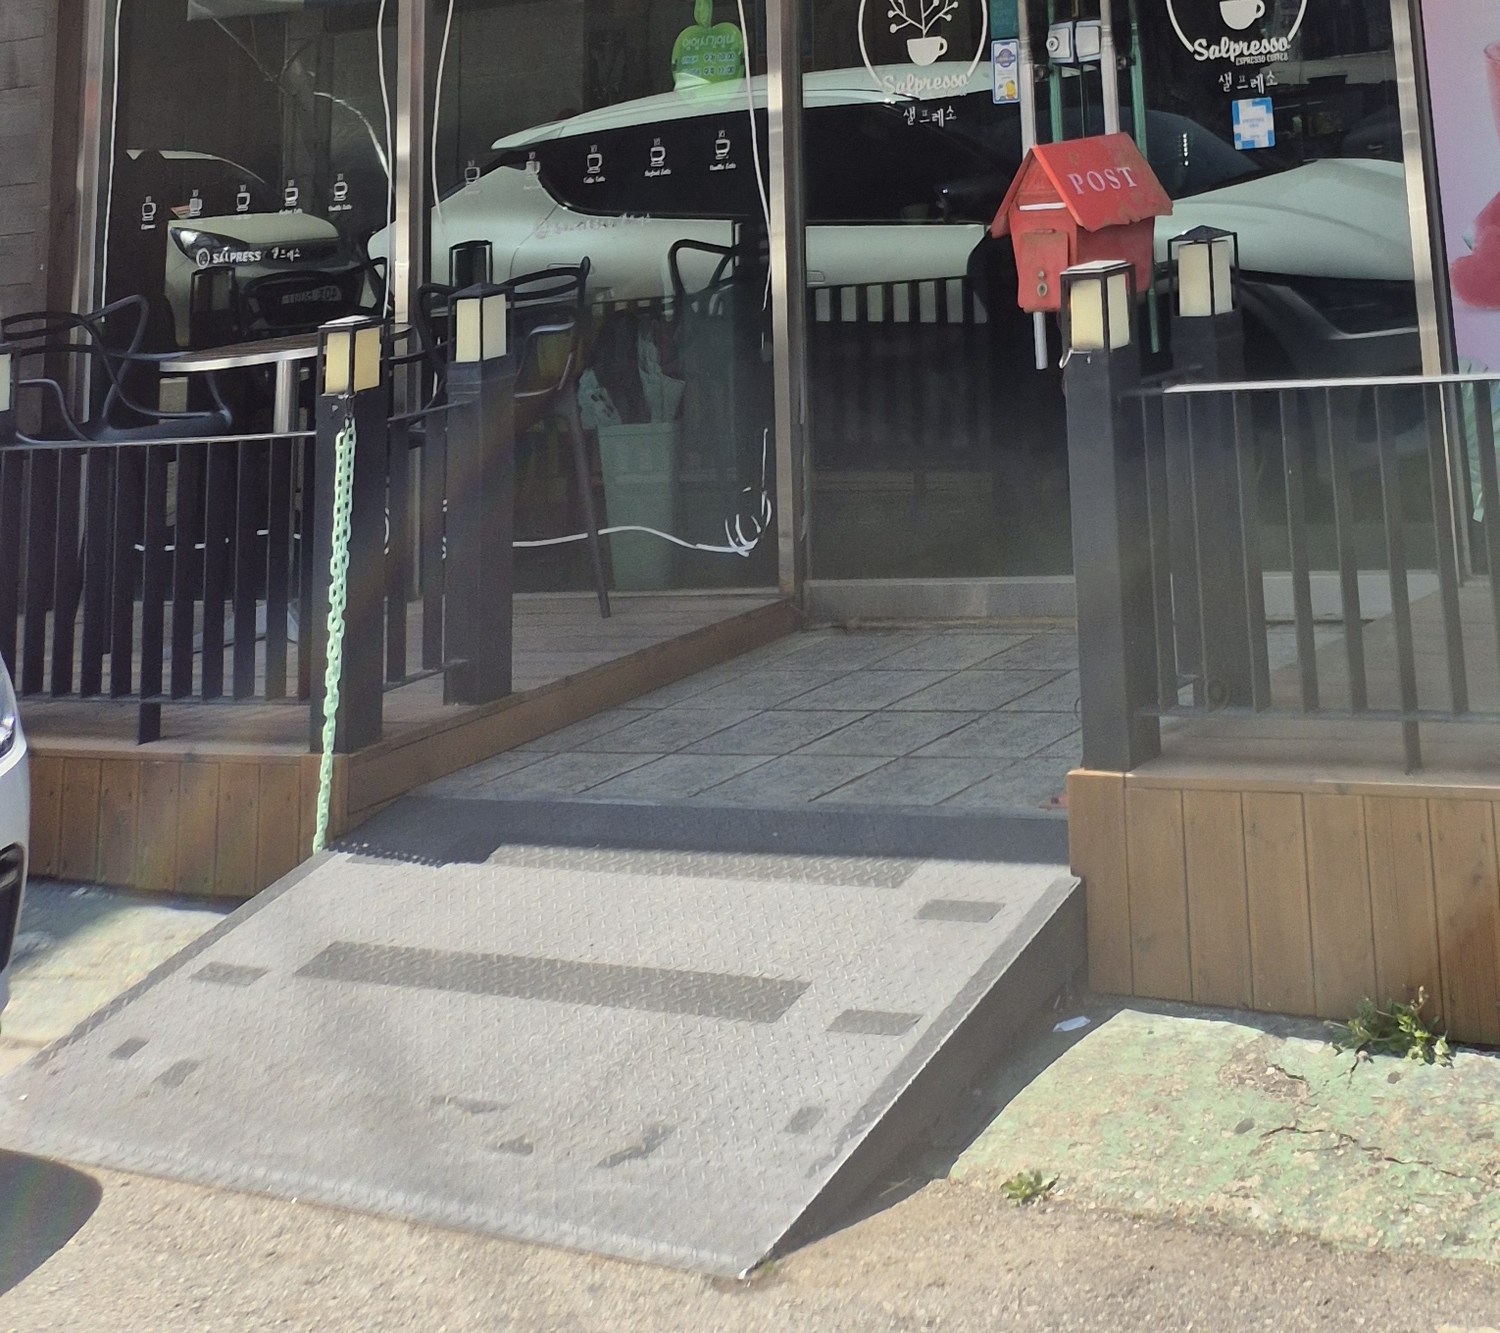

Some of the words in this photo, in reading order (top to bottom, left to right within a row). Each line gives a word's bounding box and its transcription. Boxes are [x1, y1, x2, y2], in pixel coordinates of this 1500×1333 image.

[1193, 36, 1291, 63] Salpresso
[1218, 70, 1278, 94] 샐프레소
[1067, 166, 1138, 195] POST
